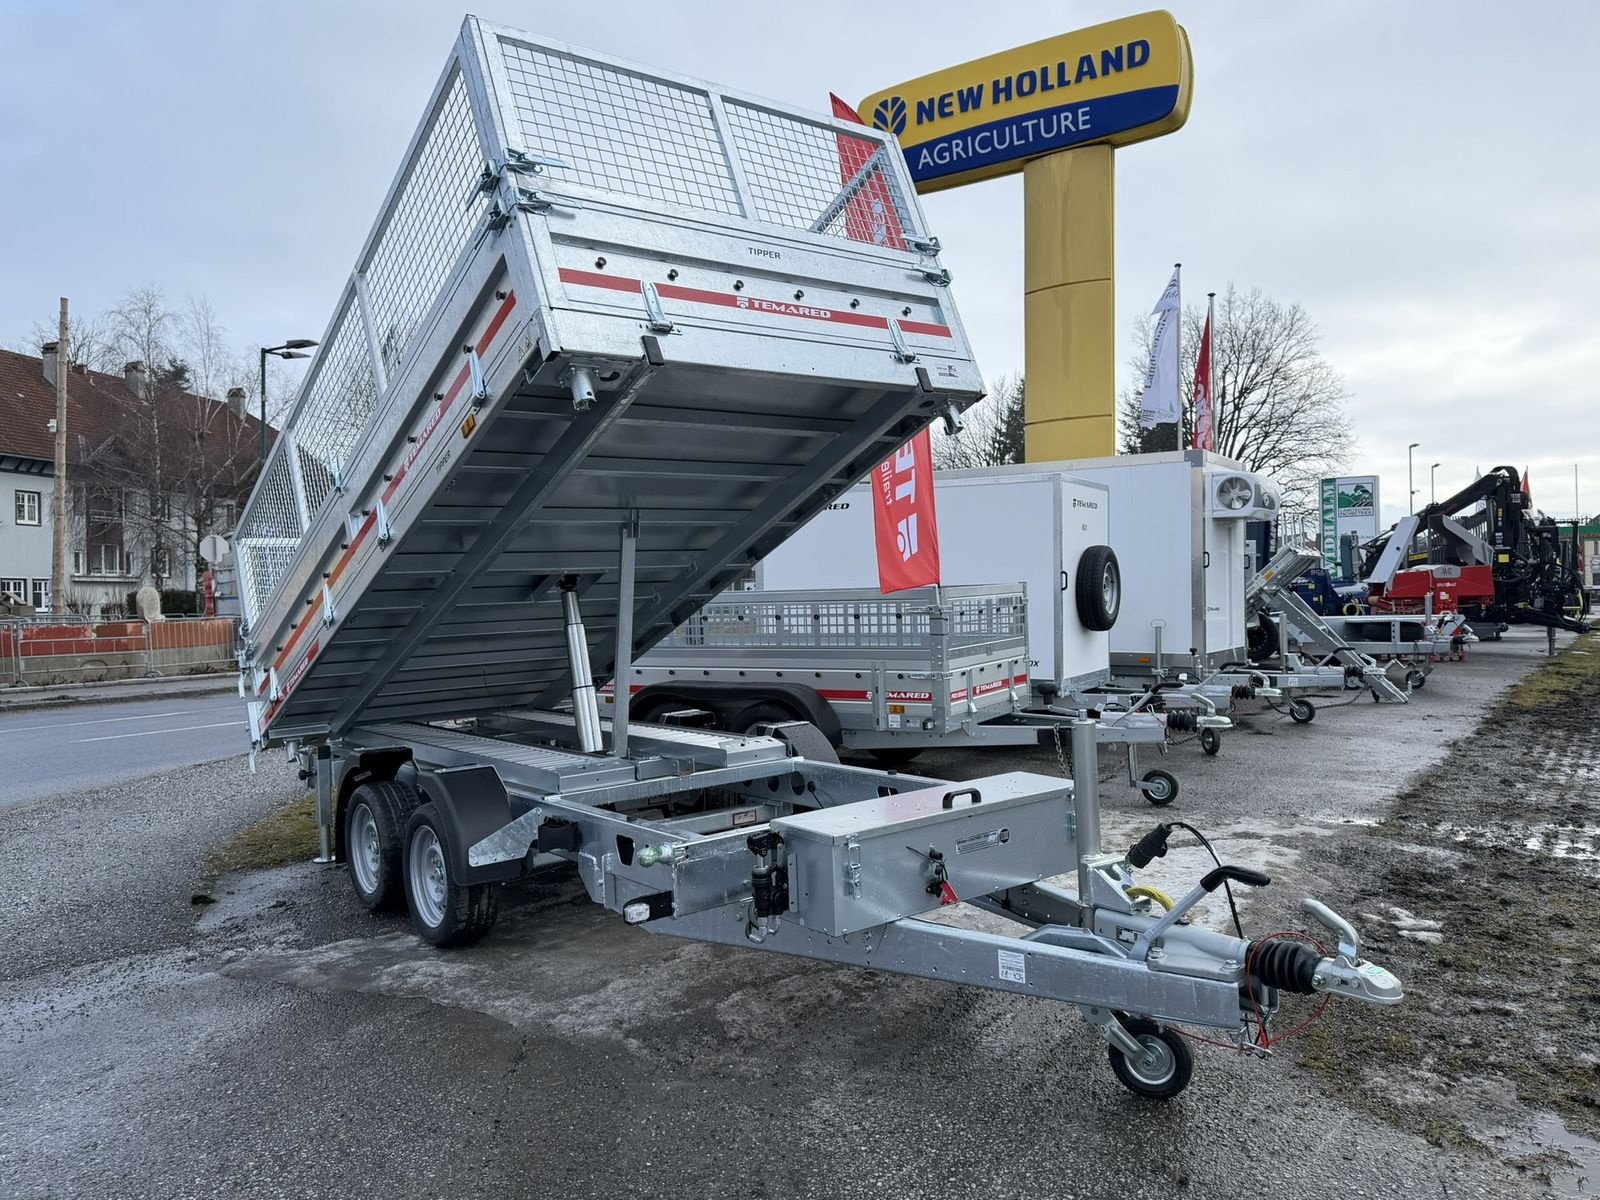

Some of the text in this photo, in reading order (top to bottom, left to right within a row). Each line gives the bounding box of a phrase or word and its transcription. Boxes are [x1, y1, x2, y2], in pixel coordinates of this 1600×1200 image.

[916, 39, 1151, 125] NEW HOLLAND
[918, 107, 1091, 170] AGRICULTURE
[748, 247, 781, 260] TIPPER
[751, 299, 832, 319] TEMARED
